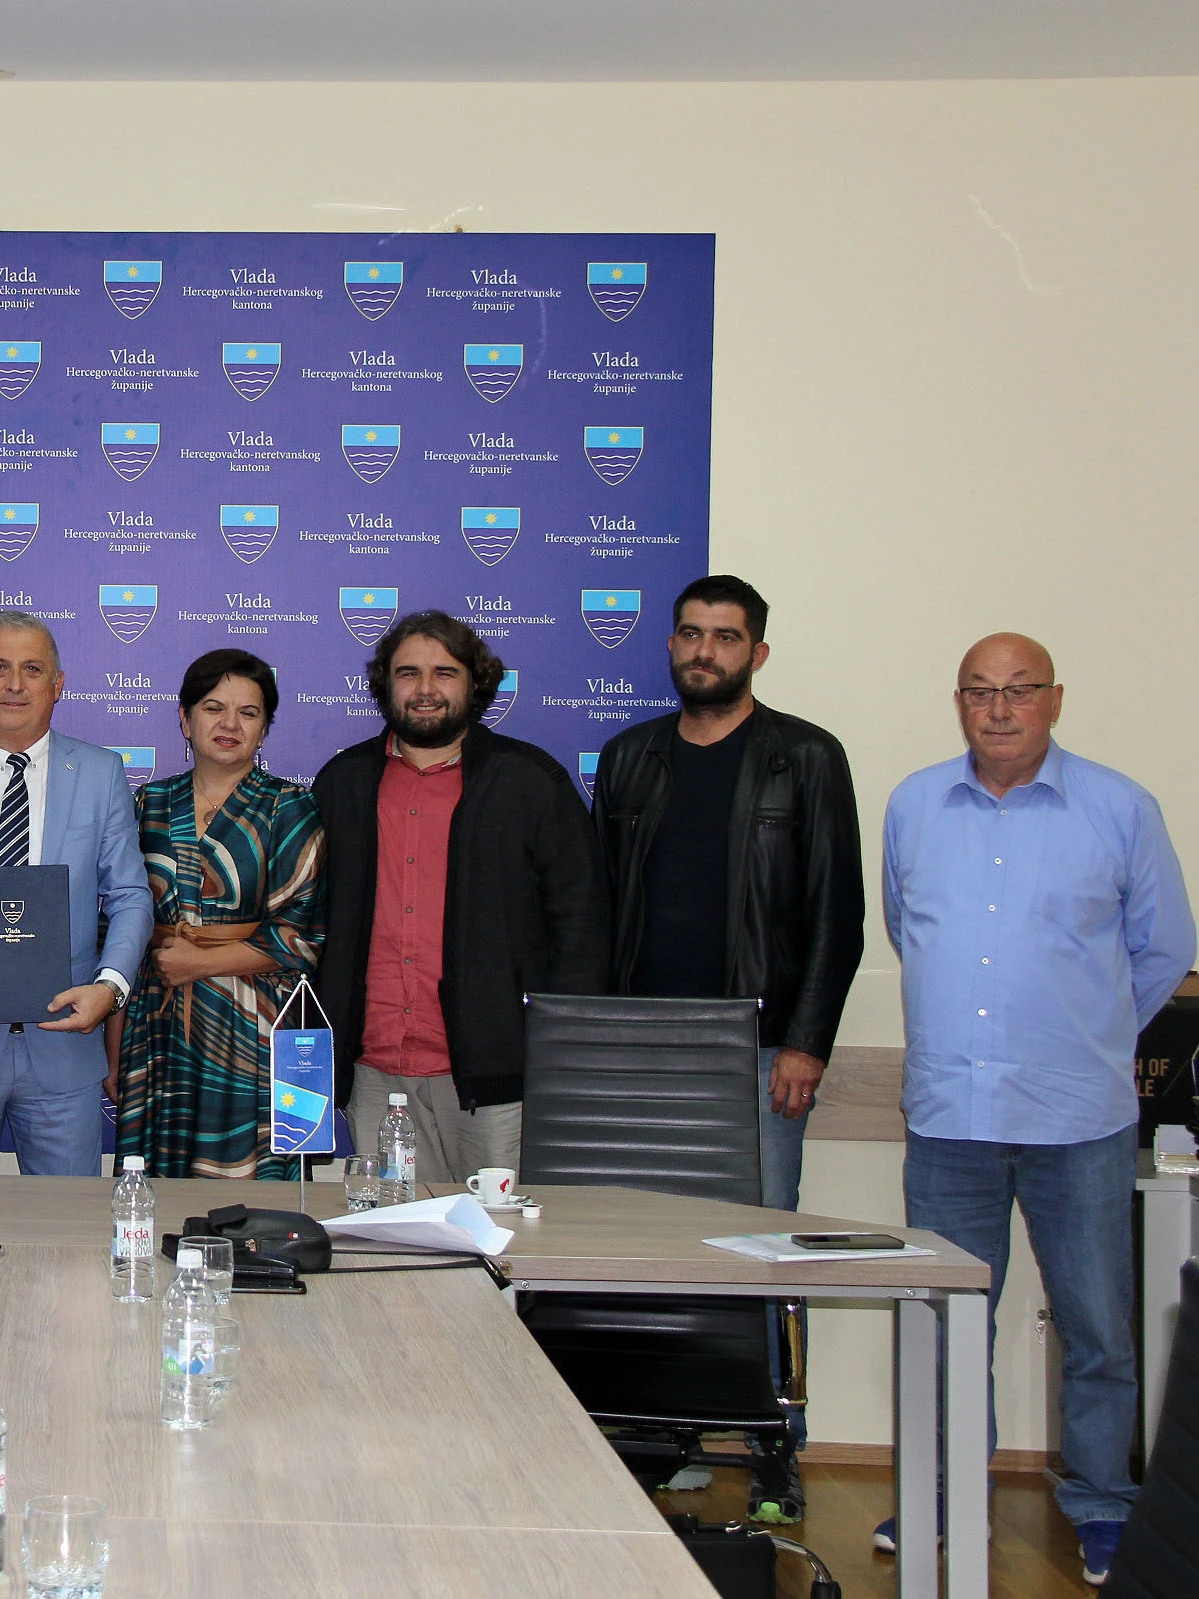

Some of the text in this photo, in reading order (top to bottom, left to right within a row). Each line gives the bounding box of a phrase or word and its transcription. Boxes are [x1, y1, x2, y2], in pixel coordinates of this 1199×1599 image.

[229, 267, 277, 284] Vlada
[470, 268, 518, 285] Vlada
[182, 285, 324, 300] Hercegovačko-neretvanskog
[426, 287, 562, 301] Hercegovačko-neretvanske
[232, 298, 273, 310] kantona
[471, 300, 516, 314] županije
[108, 348, 156, 365] Vlada
[348, 349, 396, 366] Vlada
[591, 351, 640, 368] Vlada
[66, 366, 200, 380] Hercegovačko-neretvanske
[301, 368, 443, 383] Hercegovačko-neretvanskog
[547, 369, 684, 383] Hercegovačko-neretvanske
[110, 379, 154, 393] županije
[351, 380, 393, 392] kantona
[593, 382, 637, 396] županije
[226, 430, 274, 447] Vlada
[467, 431, 516, 449] Vlada
[180, 448, 321, 463] Hercegovačko-neretvanskog
[424, 450, 559, 464] Hercegovačko-neretvanske
[229, 461, 271, 472] kantona
[468, 463, 513, 477] županije
[106, 510, 154, 527] Vlada
[345, 512, 394, 529] Vlada
[588, 514, 637, 531] Vlada
[64, 528, 197, 542] Hercegovačko-neretvanske
[299, 530, 441, 545] Hercegovačko-neretvanskog
[544, 532, 681, 547] Hercegovačko-neretvanske
[108, 541, 152, 555] županije
[348, 543, 390, 555] kantona
[590, 546, 634, 560] županije
[224, 592, 272, 609] Vlada
[465, 595, 513, 611] Vlada
[178, 610, 319, 625] Hercegovačko-neretvanskog
[227, 623, 268, 634] kantona
[105, 672, 152, 688] Vlada
[344, 675, 370, 691] Vla
[585, 677, 634, 694] Vlada
[61, 690, 181, 704] Hercegovačko-neretvan
[541, 695, 678, 709] Hercegovačko-neretvanske
[106, 703, 149, 717] županije
[587, 709, 631, 723] županije
[1148, 1058, 1170, 1076] OF
